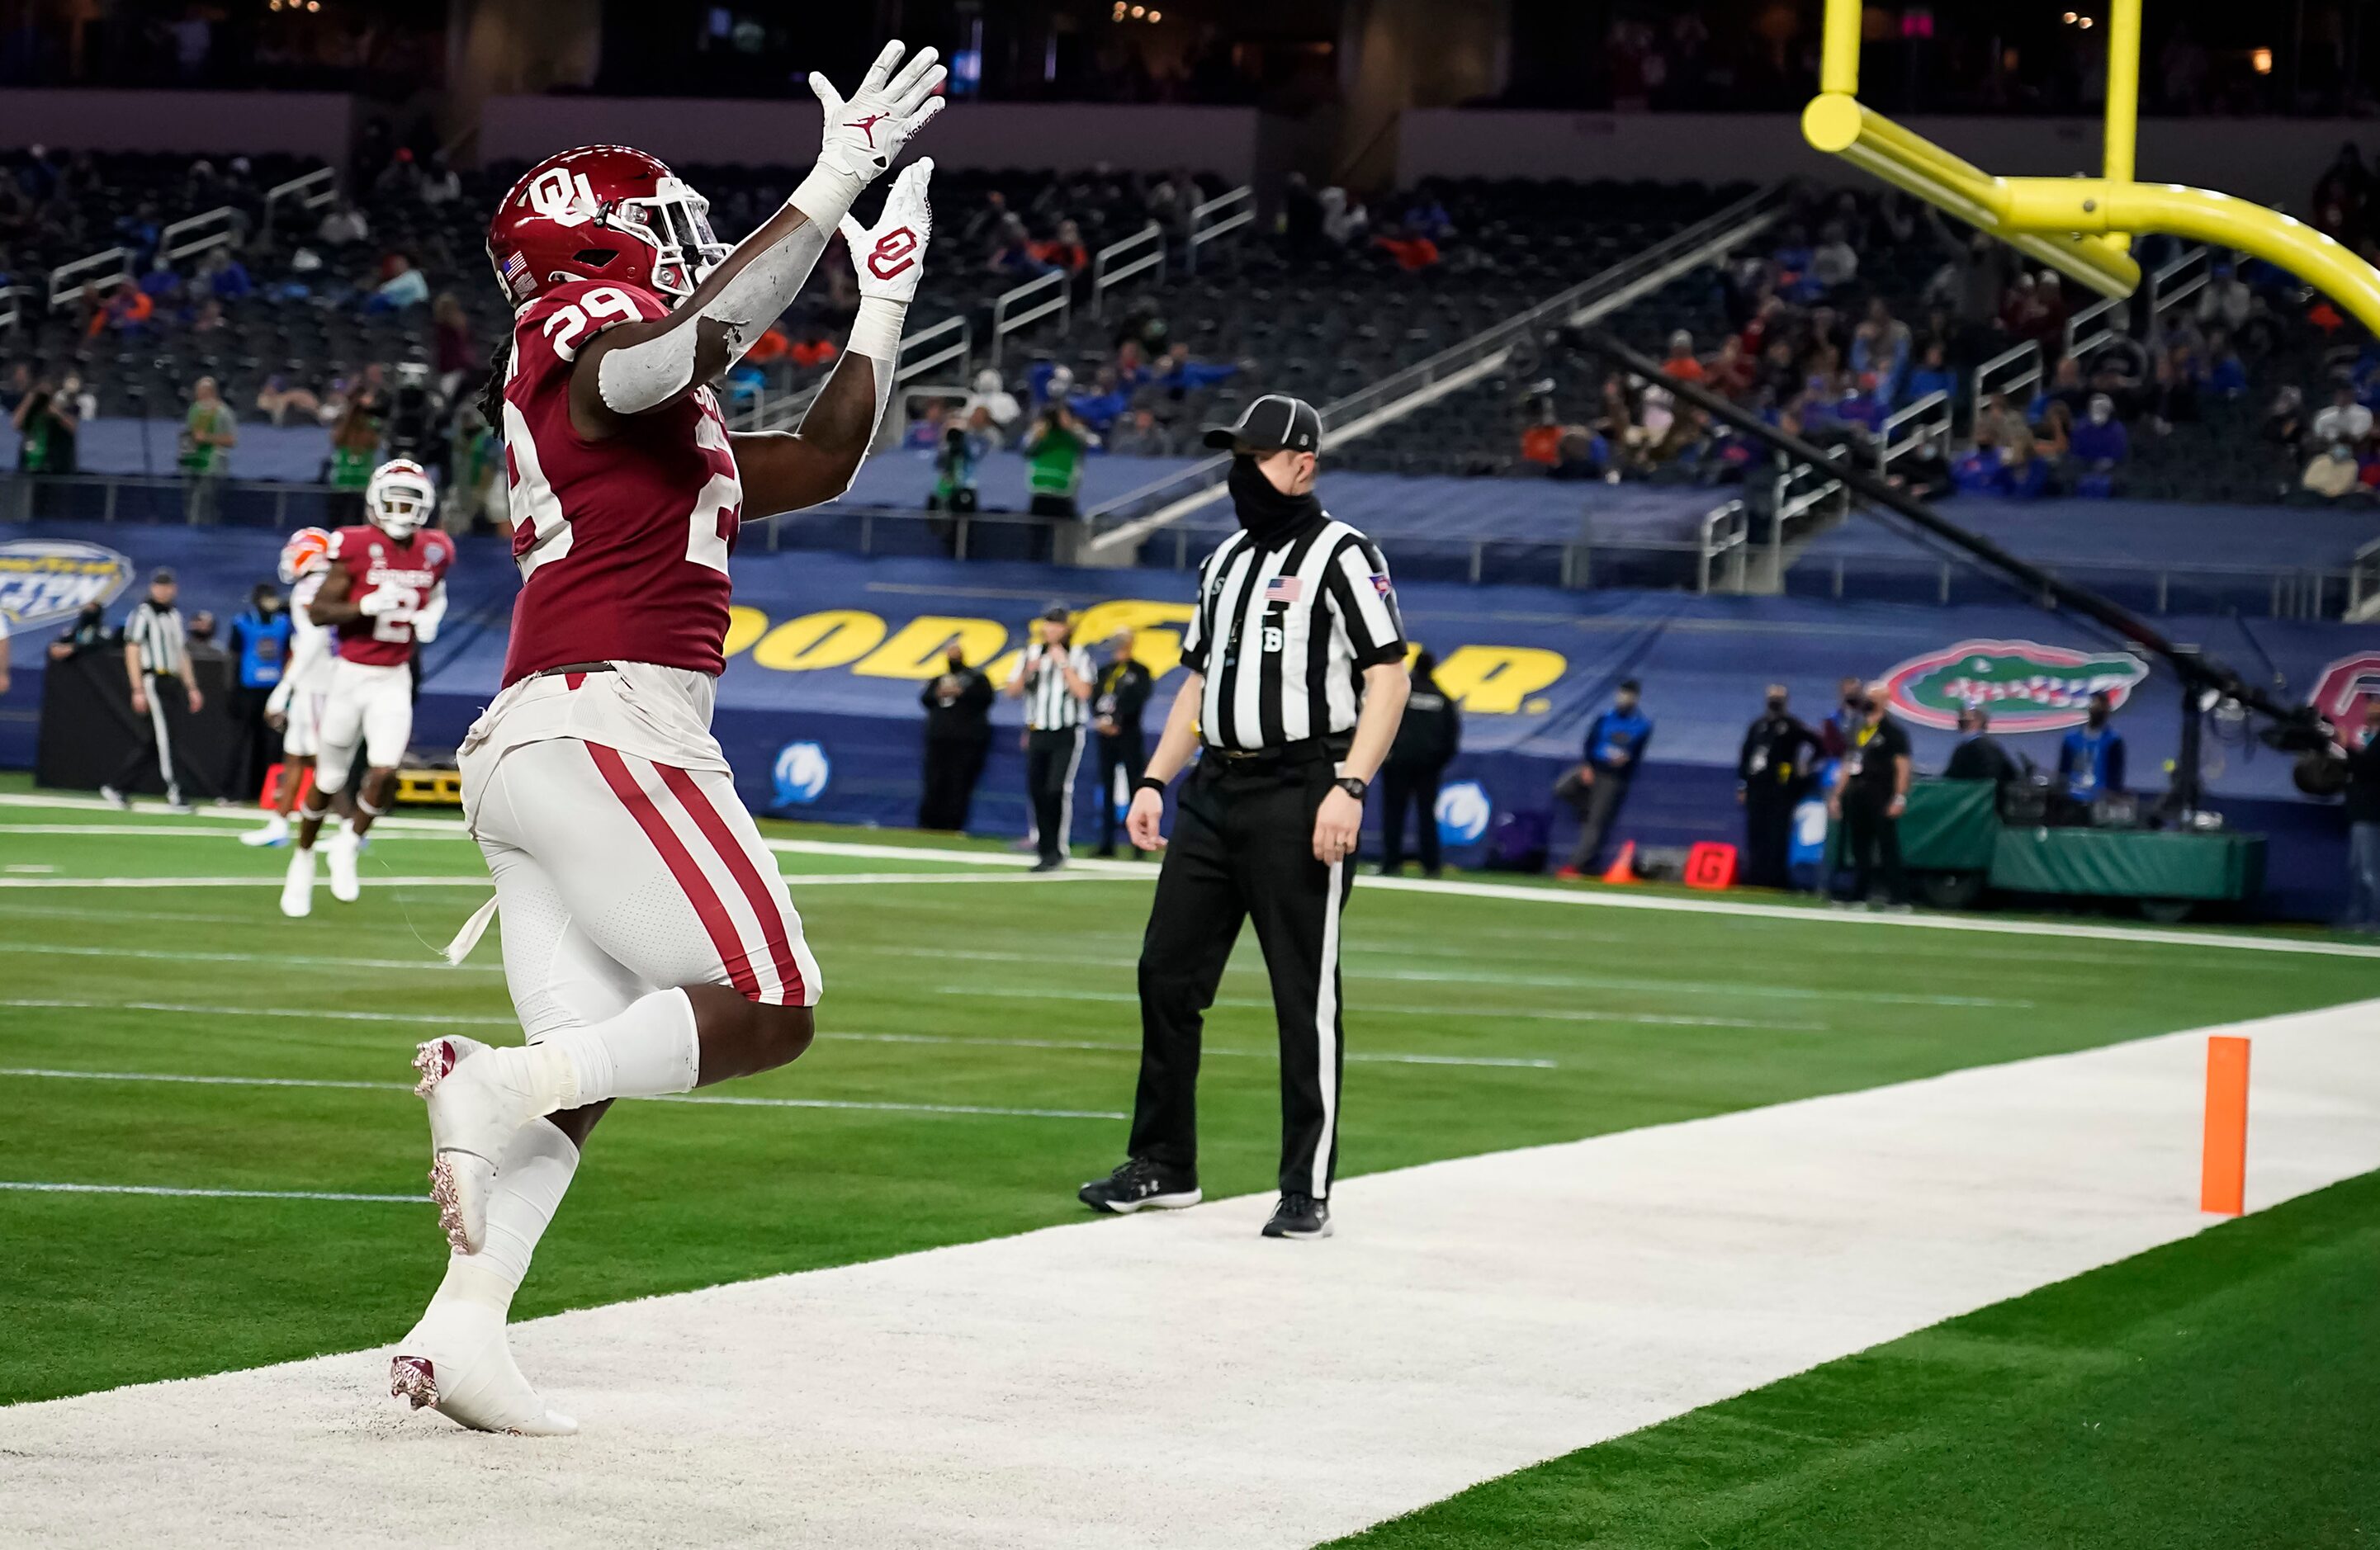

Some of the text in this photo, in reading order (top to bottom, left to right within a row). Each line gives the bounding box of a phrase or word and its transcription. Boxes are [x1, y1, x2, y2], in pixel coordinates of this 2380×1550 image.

[529, 168, 598, 228] OU
[543, 287, 643, 362] 29
[373, 587, 420, 643] 2
[1264, 626, 1283, 652] B
[1696, 851, 1724, 883] G
